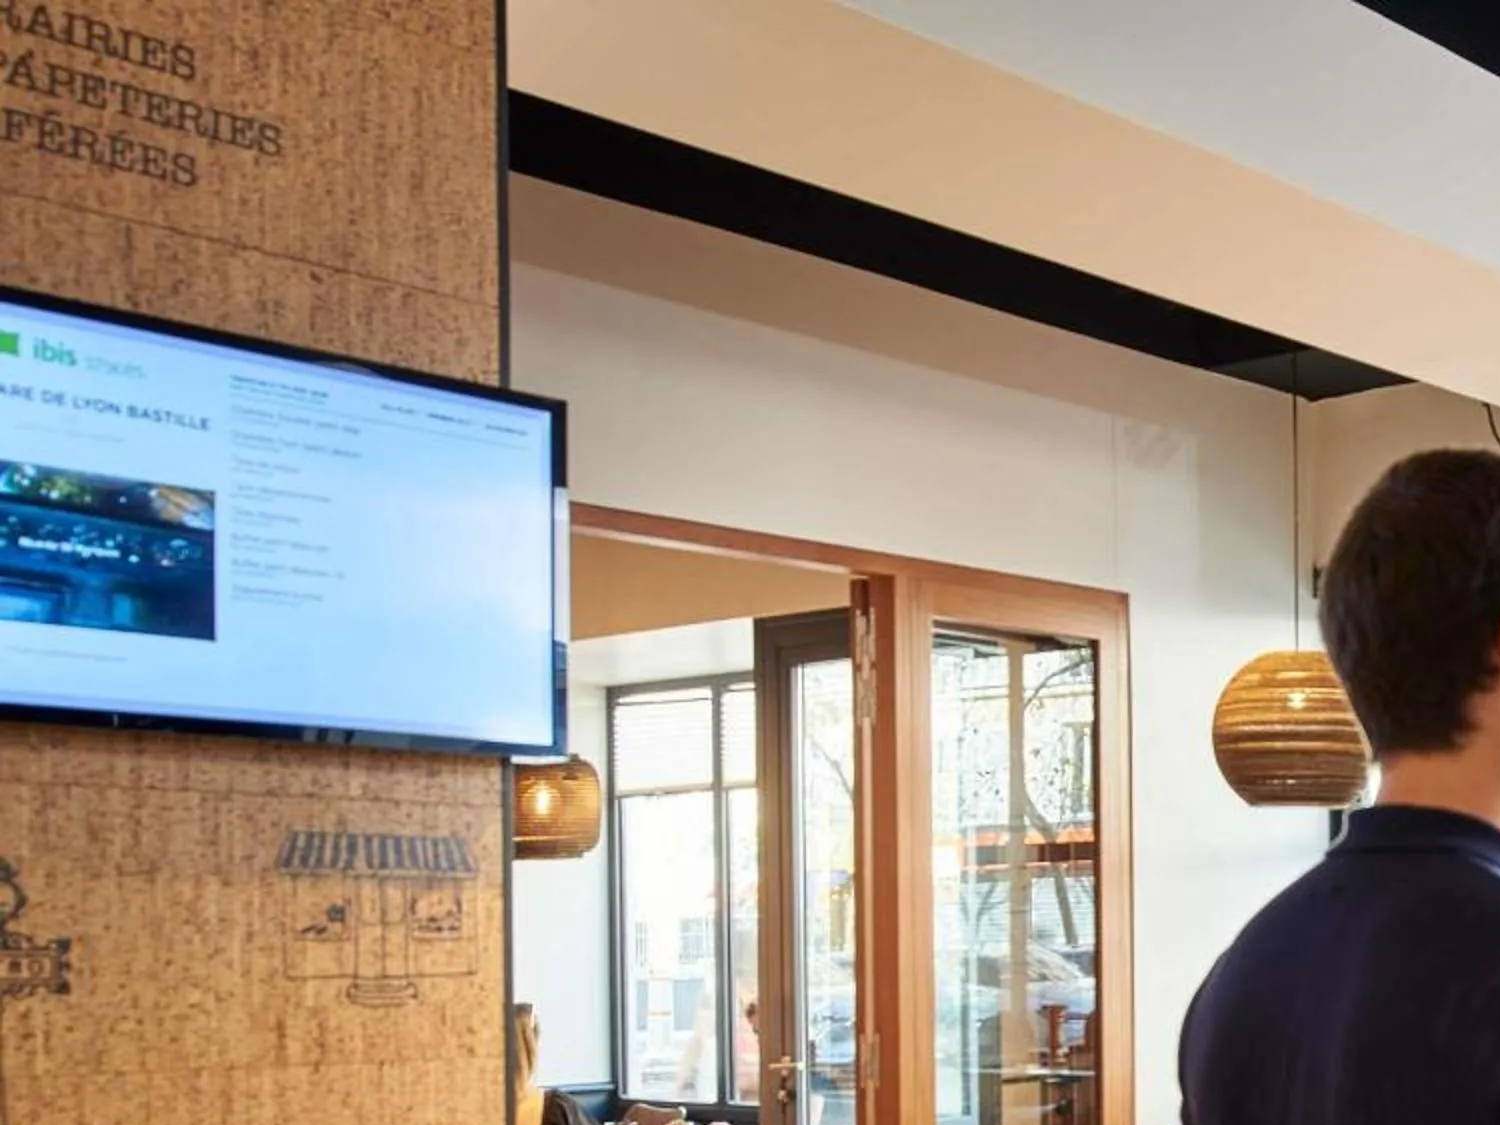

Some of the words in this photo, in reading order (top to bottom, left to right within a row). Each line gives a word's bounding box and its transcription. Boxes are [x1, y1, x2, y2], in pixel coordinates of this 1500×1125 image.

[0, 51, 283, 156] APETERIES
[33, 337, 77, 366] ibis
[41, 389, 67, 407] DE
[72, 395, 121, 415] LYON
[127, 405, 210, 431] BASTILLE
